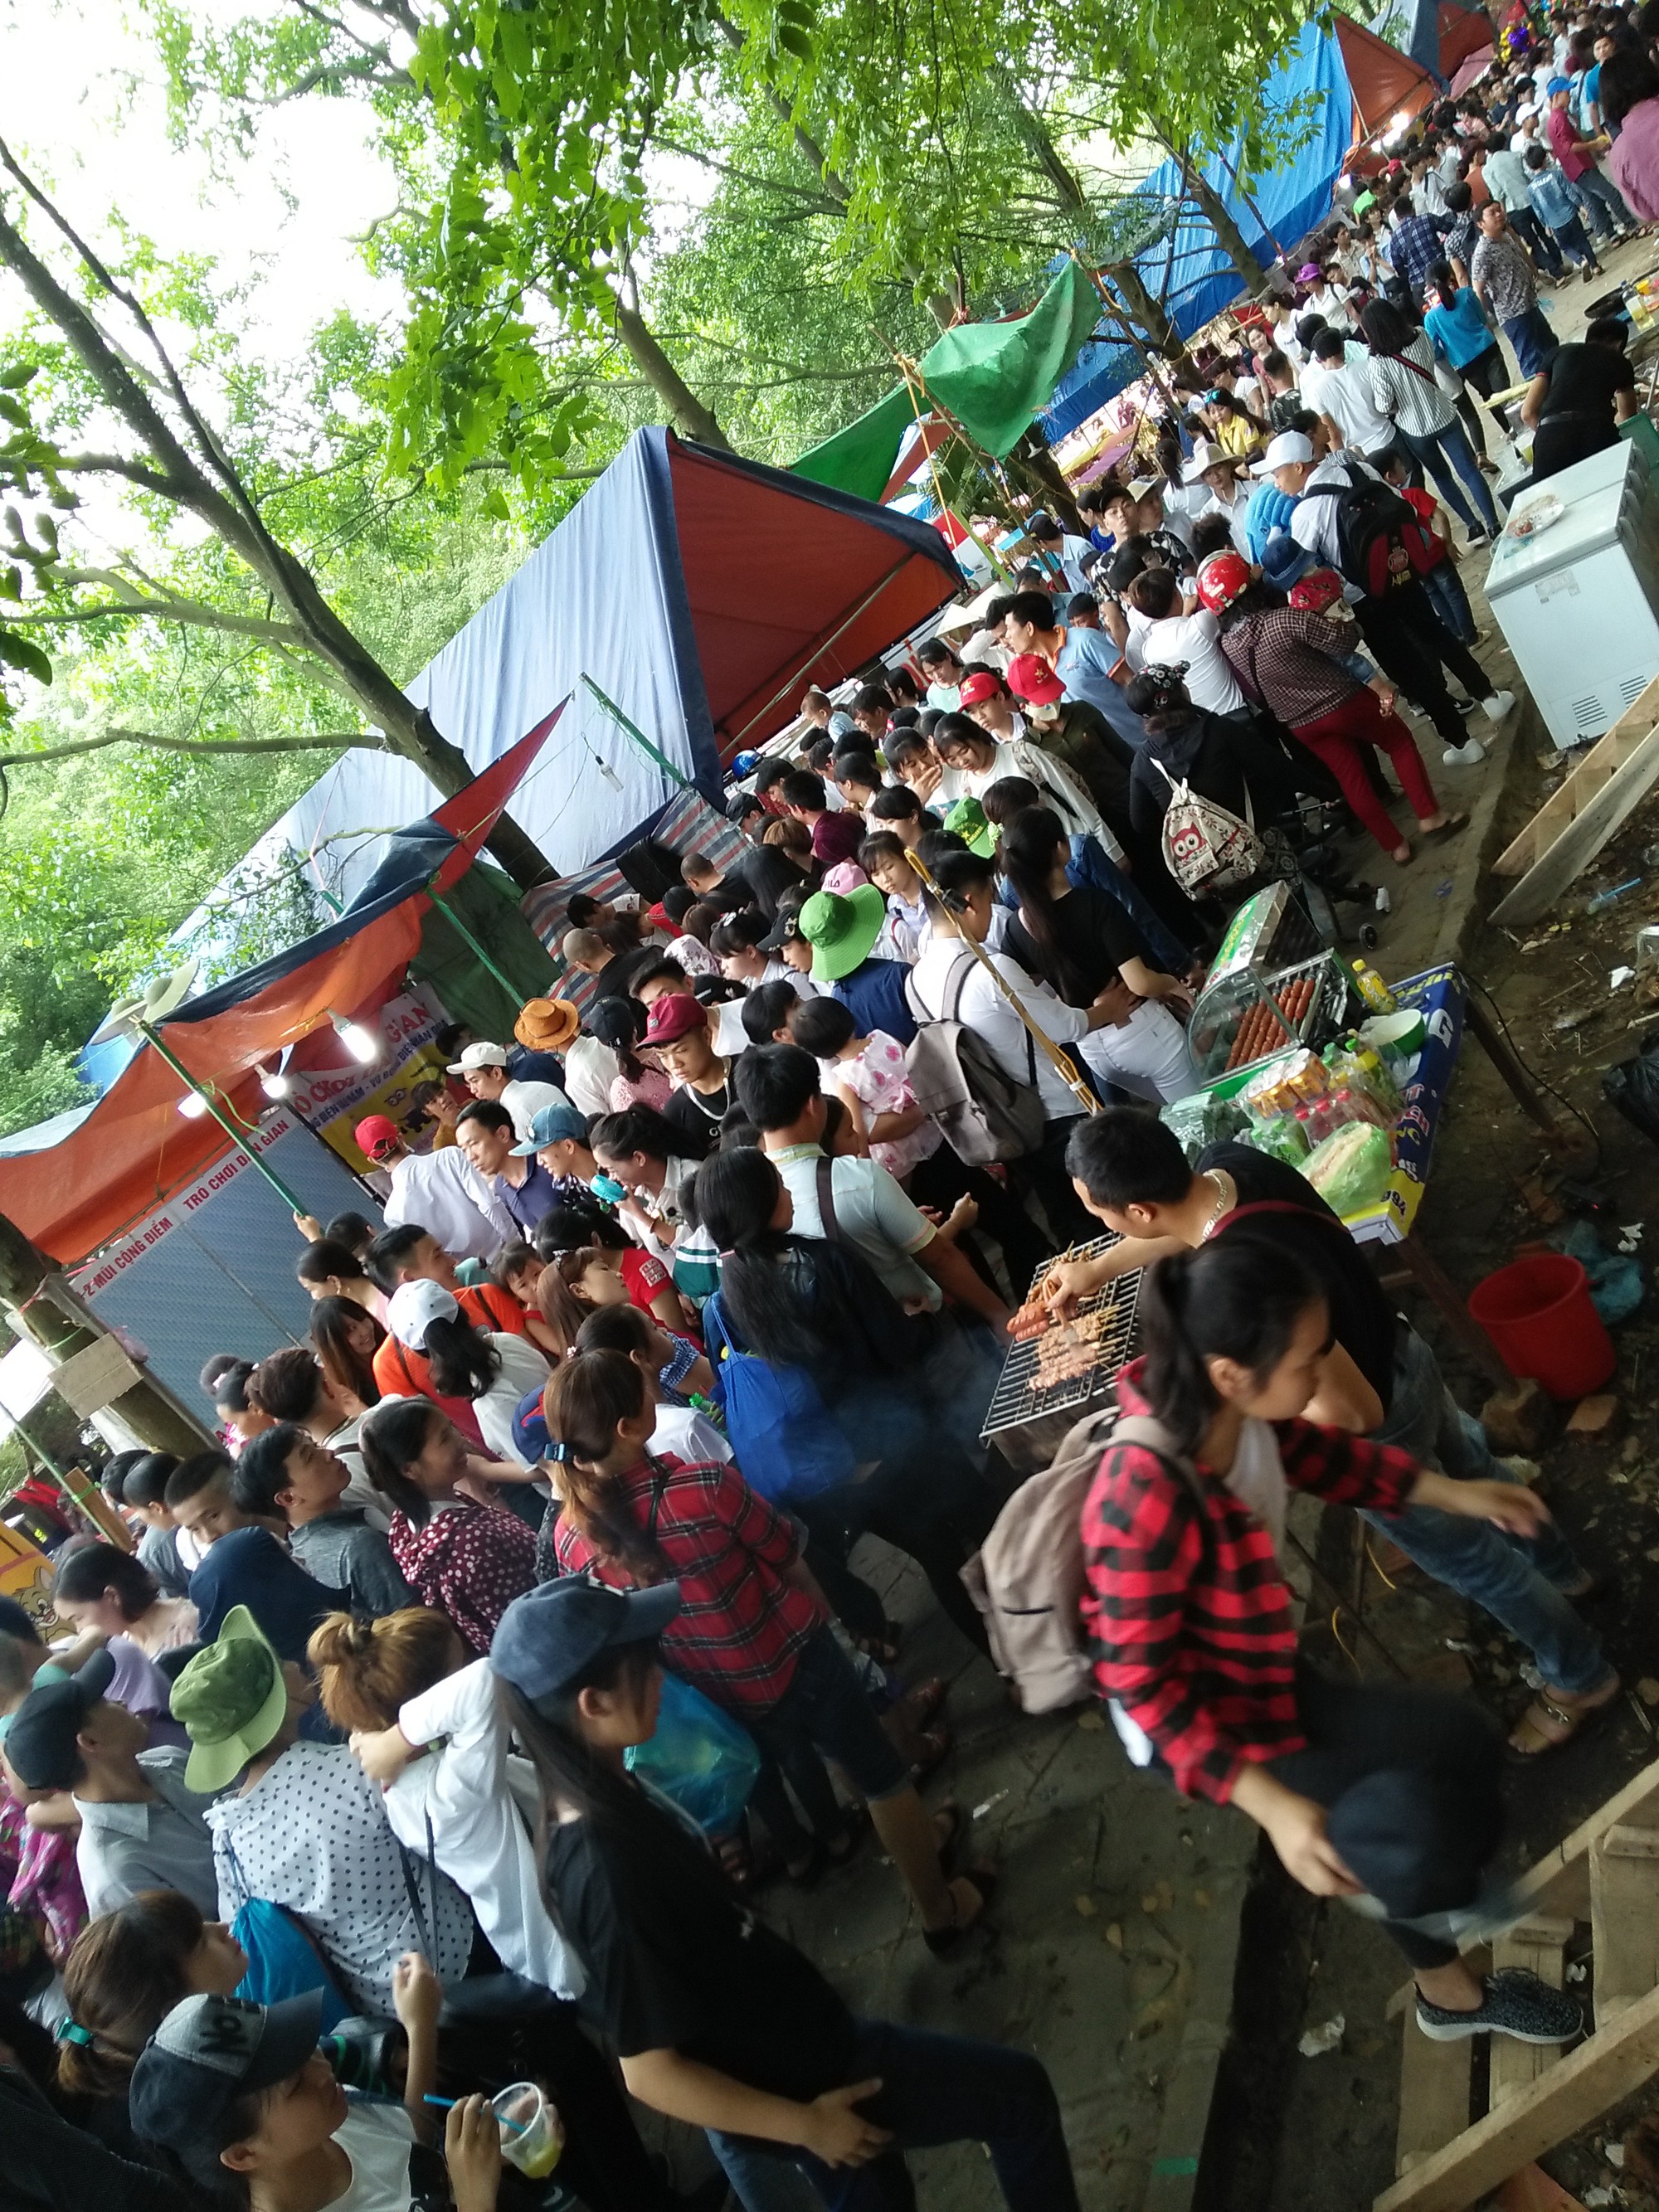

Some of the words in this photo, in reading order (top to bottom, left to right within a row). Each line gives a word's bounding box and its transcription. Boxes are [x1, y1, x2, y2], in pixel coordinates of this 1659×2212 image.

[114, 1240, 147, 1269] CỘNG
[143, 1217, 173, 1245] ĐIỂM
[182, 1186, 210, 1210] TRÒ
[207, 1162, 239, 1190] CHƠI
[236, 1142, 263, 1167] DN
[260, 1120, 289, 1146] GIAN
